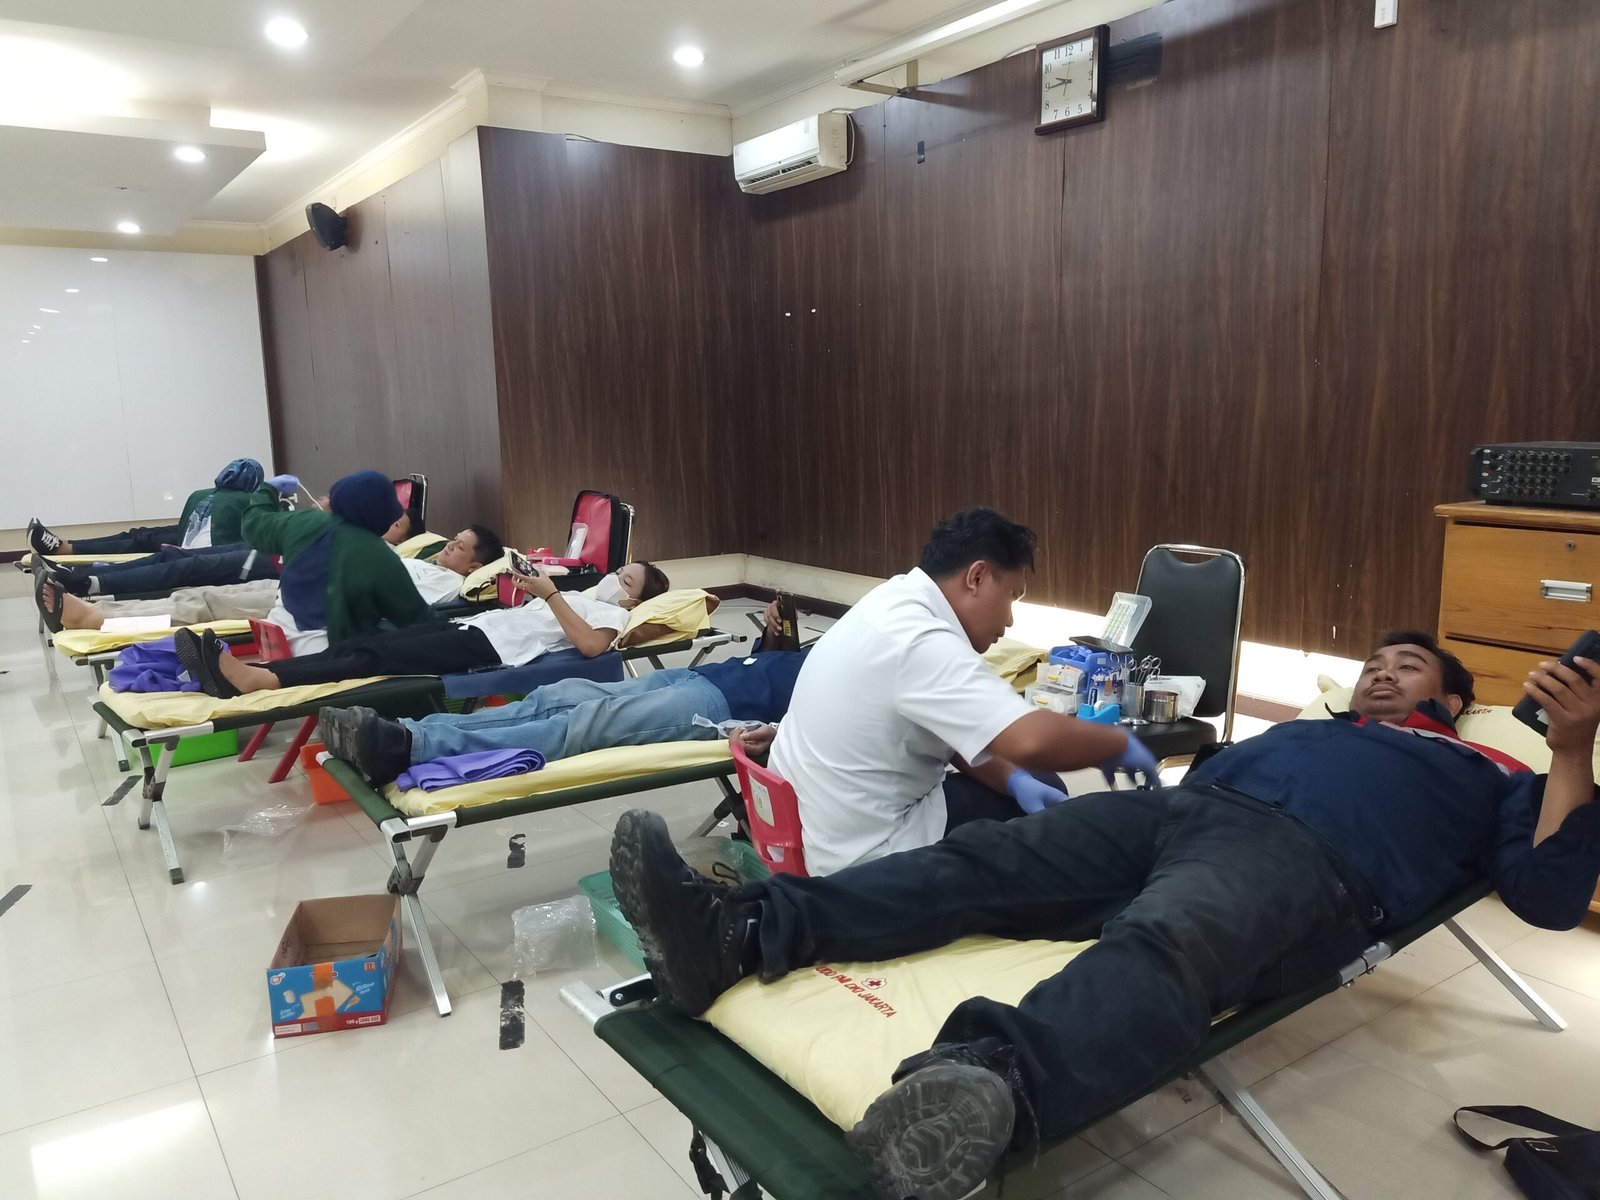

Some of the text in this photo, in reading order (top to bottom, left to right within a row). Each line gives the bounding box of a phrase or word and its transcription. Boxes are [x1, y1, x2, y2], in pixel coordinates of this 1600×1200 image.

[1054, 49, 1061, 60] 11
[1065, 45, 1074, 57] 12
[1044, 63, 1052, 75] 10
[1045, 82, 1051, 93] 9
[1044, 100, 1050, 110] 8
[1077, 104, 1083, 115] 5
[1053, 109, 1058, 119] 7
[1065, 107, 1070, 117] 6
[857, 993, 897, 1018] JAKARTA
